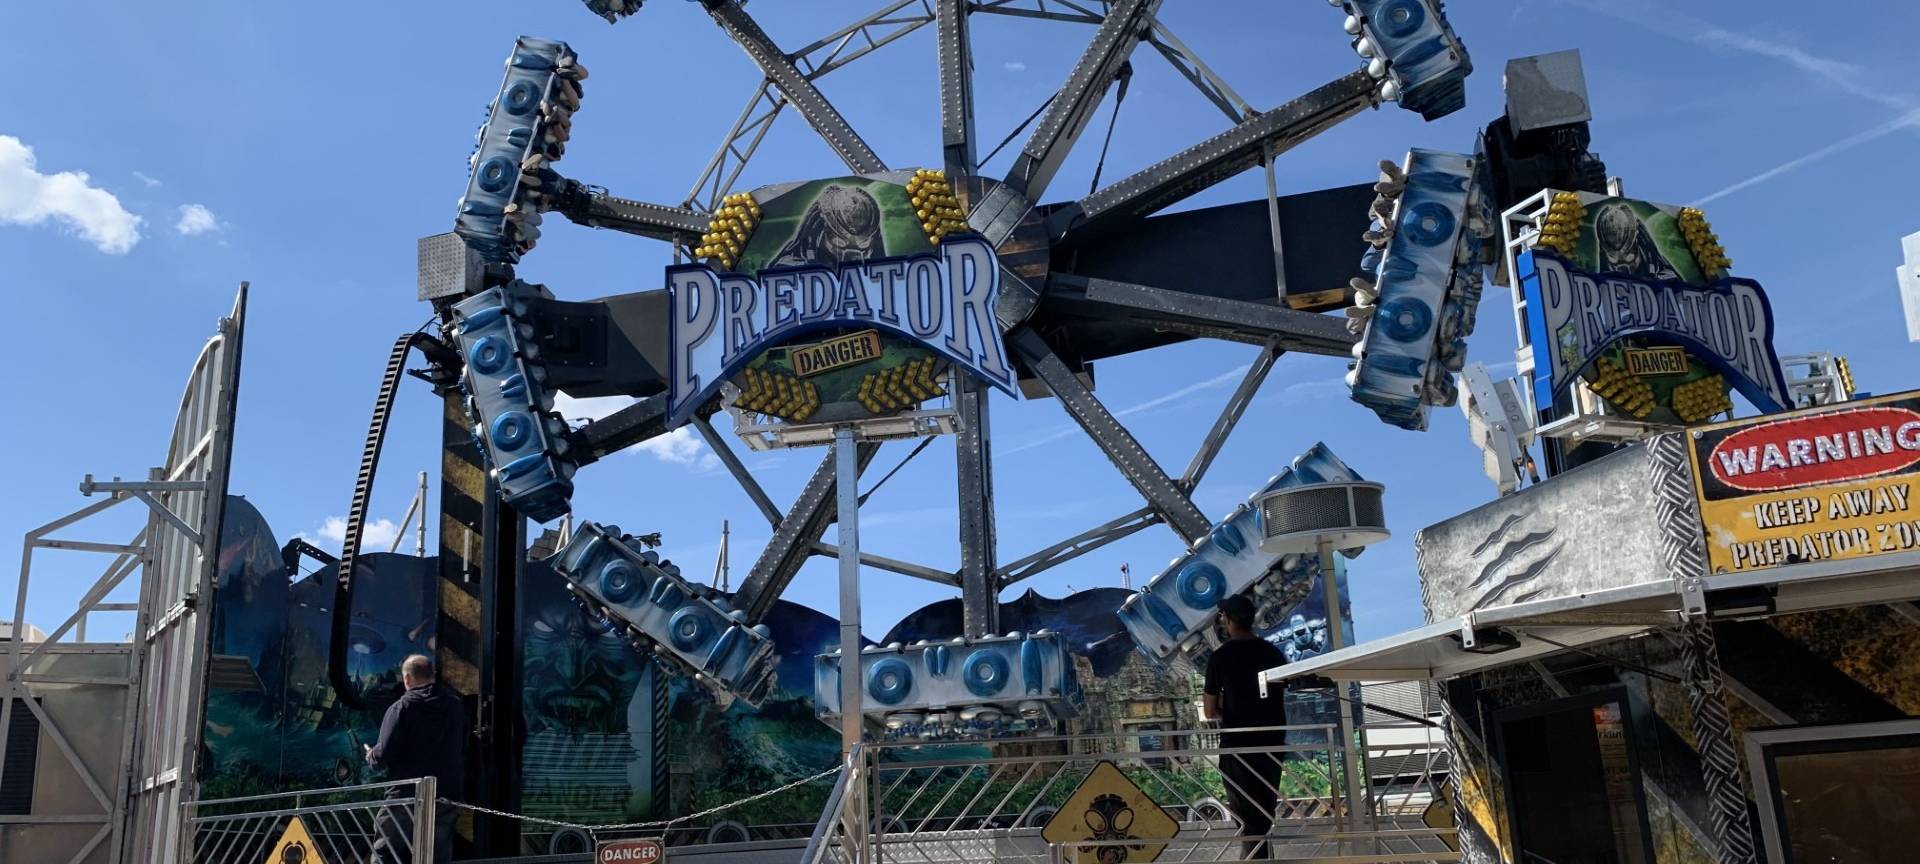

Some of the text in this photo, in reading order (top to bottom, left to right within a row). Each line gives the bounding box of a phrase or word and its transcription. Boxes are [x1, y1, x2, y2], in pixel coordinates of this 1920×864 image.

[669, 237, 1017, 417] PREDATOR
[1535, 254, 1780, 400] PREDATOR
[798, 335, 875, 374] DANGER
[1631, 352, 1685, 374] DANGER
[1717, 421, 1920, 477] WARNING
[1753, 483, 1910, 530] KEEP AWAY
[1730, 528, 1872, 570] PREDATOR
[604, 846, 656, 862] DANGER
